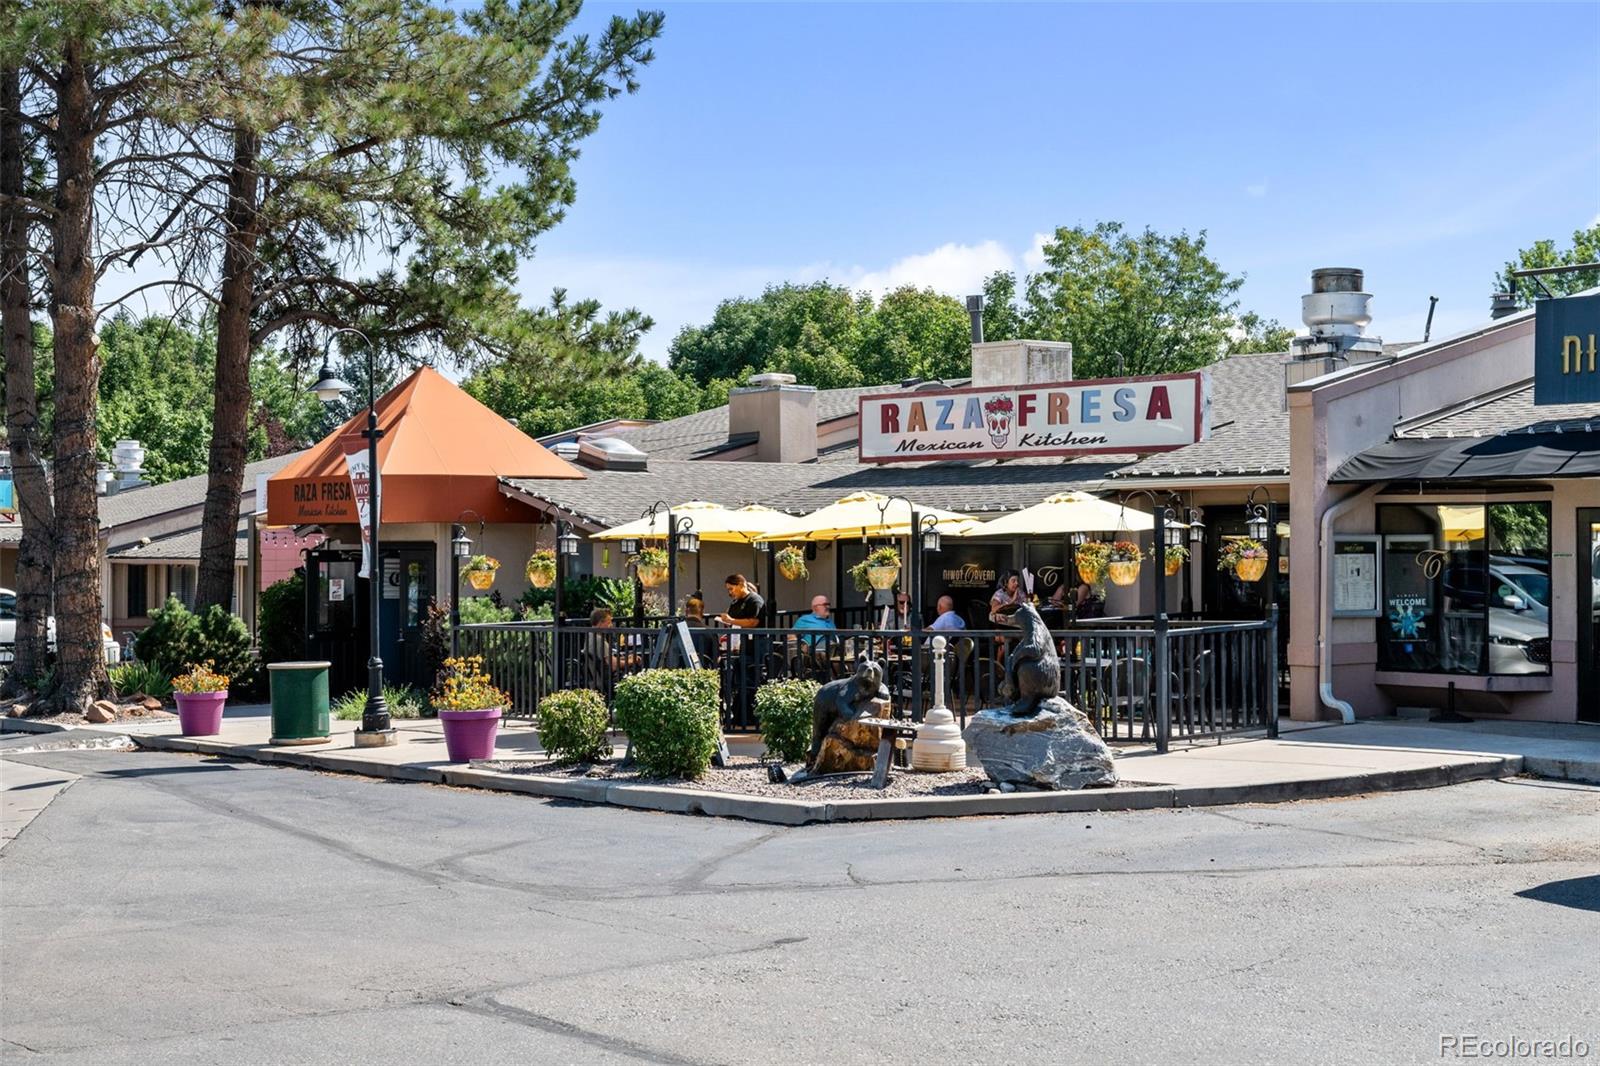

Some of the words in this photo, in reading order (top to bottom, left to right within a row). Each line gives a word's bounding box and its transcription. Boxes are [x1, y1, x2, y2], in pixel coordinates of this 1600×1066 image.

[881, 397, 984, 434] RAZA
[1018, 386, 1172, 427] FRESA
[895, 438, 984, 453] Mexican
[1018, 431, 1108, 447] Kitchen
[294, 483, 318, 502] RAZA
[321, 482, 352, 501] FRESA
[943, 569, 963, 581] NIWOT
[960, 563, 996, 584] TAVERN
[1389, 598, 1427, 606] WELCOME
